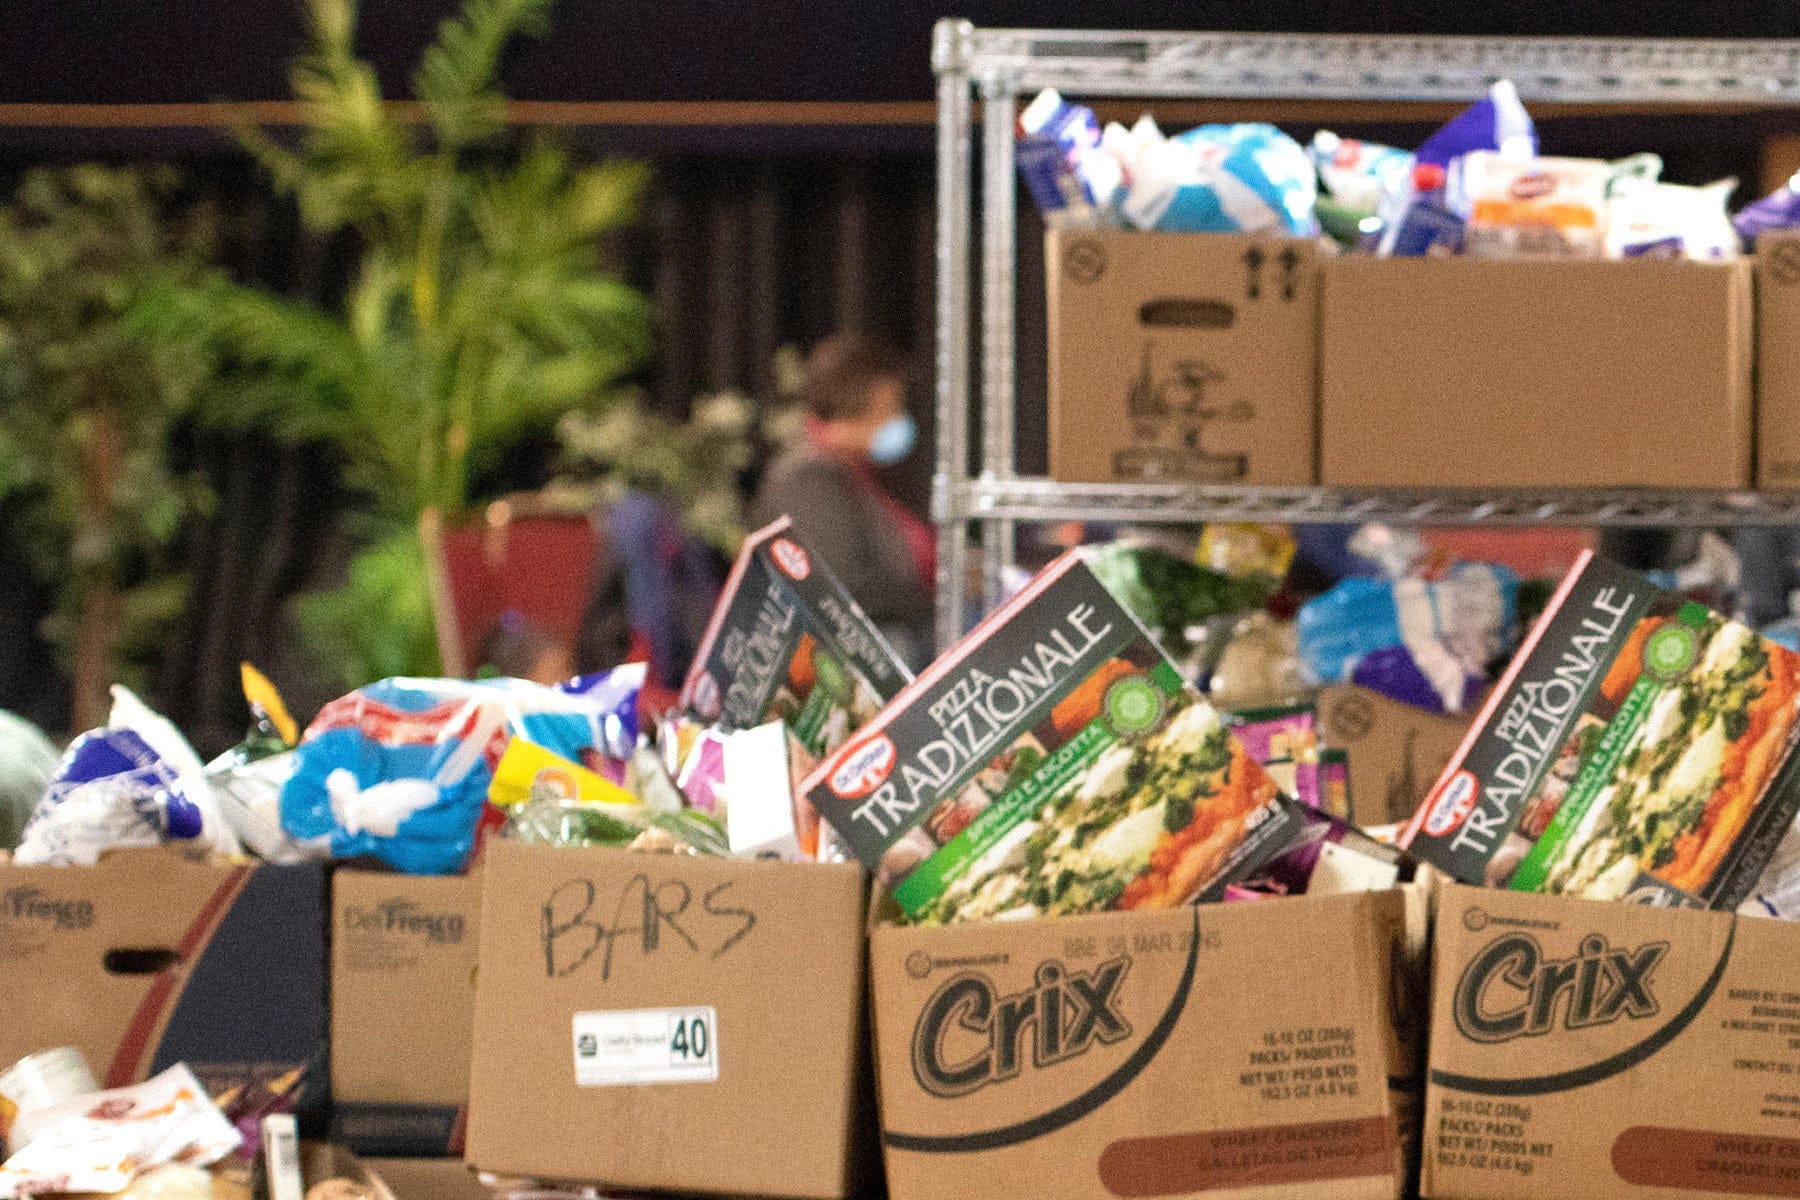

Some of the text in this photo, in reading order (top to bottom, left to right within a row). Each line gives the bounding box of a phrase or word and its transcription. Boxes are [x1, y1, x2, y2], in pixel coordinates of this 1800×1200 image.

[851, 602, 1113, 838] TRADIZIONALE
[928, 668, 993, 728] PIZZA
[1450, 586, 1636, 854] TRADIZIONALE
[1494, 680, 1545, 741] PIZZA
[1601, 681, 1650, 752] RICOTTA
[1035, 724, 1102, 782] RICOTTA
[541, 873, 758, 982] BARS
[1453, 930, 1671, 1044] Crix
[671, 1017, 708, 1060] 40
[910, 954, 1134, 1099] Crix
[1296, 1028, 1314, 1044] OZ
[1239, 1072, 1261, 1086] NET
[1292, 1067, 1323, 1080] PESO
[1325, 1064, 1357, 1079] NETO
[1293, 1083, 1311, 1098] OZ
[1474, 1100, 1493, 1116] OZ
[1485, 1121, 1524, 1139] PACKS
[1438, 1135, 1460, 1150] NET
[1490, 1139, 1528, 1155] POIDS
[1529, 1142, 1555, 1158] NET
[1469, 1154, 1488, 1169] OZ
[1714, 1140, 1773, 1156] WHEAT
